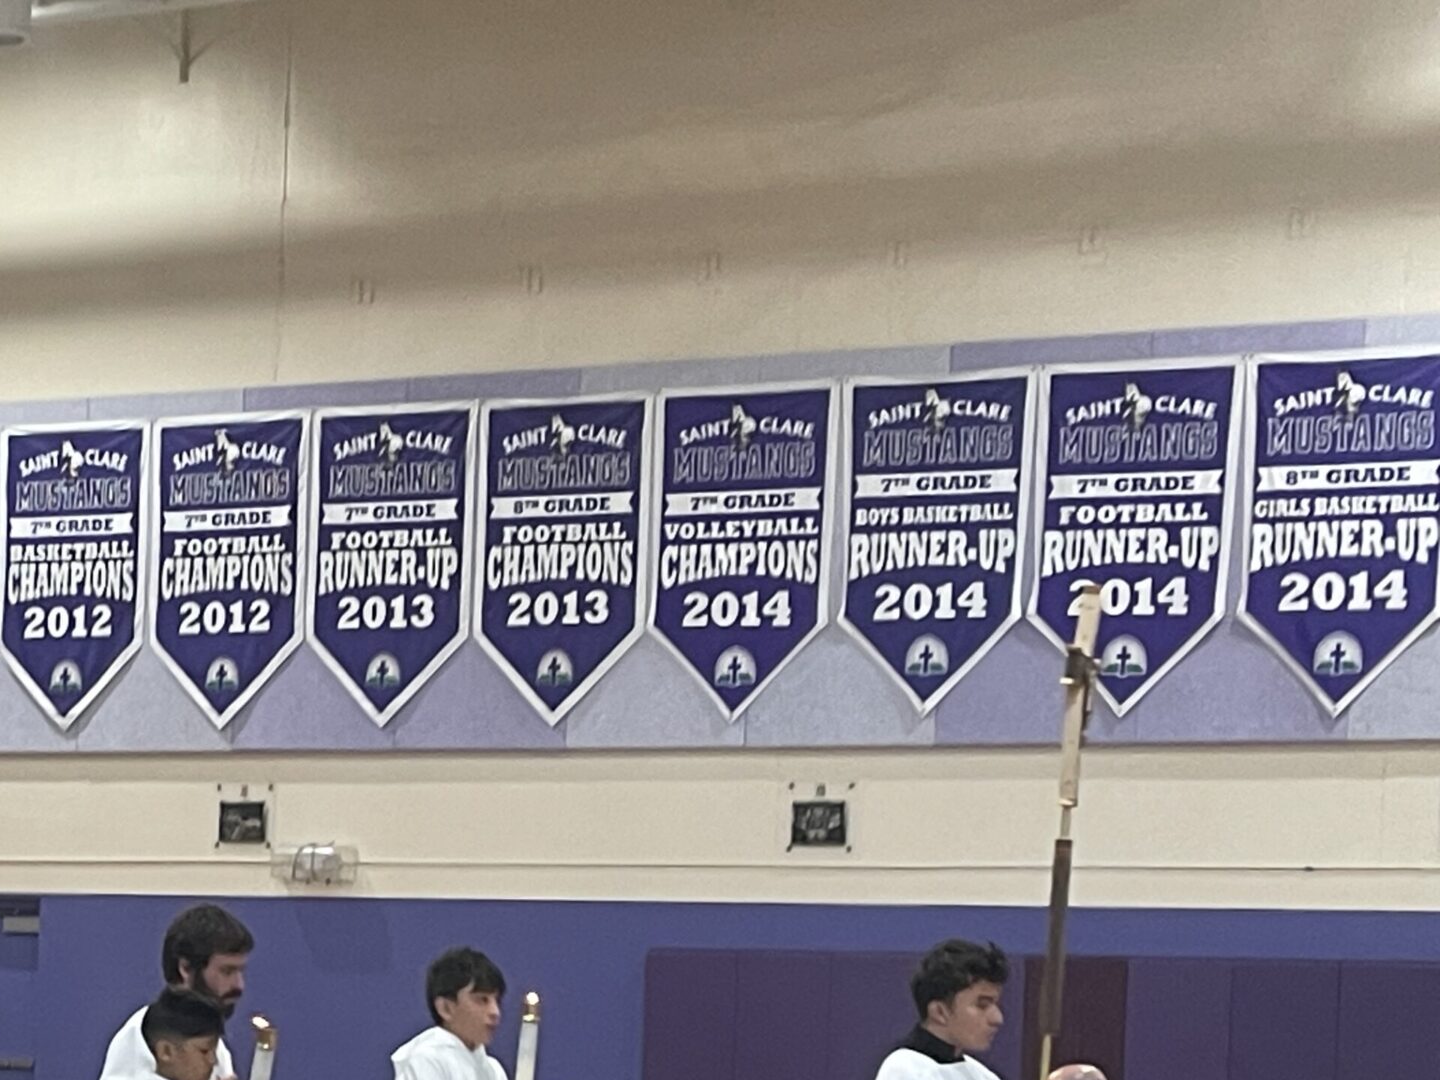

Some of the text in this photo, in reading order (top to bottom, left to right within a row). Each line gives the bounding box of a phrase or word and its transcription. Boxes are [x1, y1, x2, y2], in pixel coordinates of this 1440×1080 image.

[869, 400, 1012, 429] SAINT CLARE
[1066, 396, 1217, 425] SAINT CLARE
[1274, 384, 1434, 417] SAINT CLARE
[333, 430, 452, 460] SAINT CLARE
[503, 424, 627, 454] SAINT CLARE
[680, 416, 815, 445] SAINT CLARE
[863, 424, 1014, 467] MUSTANGS
[1059, 421, 1219, 465] MUSTANGS
[1266, 410, 1435, 456] MUSTANGS
[19, 449, 128, 477] SAINT CLARE
[173, 442, 286, 471] SAINT CLARE
[498, 452, 631, 491] MUSTANGS
[673, 441, 815, 484] MUSTANGS
[169, 469, 290, 506] MUSTANGS
[329, 460, 456, 498] MUSTANGS
[916, 474, 992, 491] GRADE
[1114, 476, 1195, 492] GRADE
[1326, 467, 1411, 484] GRADE
[15, 477, 131, 512] MUSTANGS
[544, 497, 610, 512] GRADE
[724, 493, 795, 509] GRADE
[1254, 492, 1440, 518] GIRLS BASKETBALL
[56, 518, 113, 532] GRADE
[212, 511, 271, 526] GRADE
[373, 504, 436, 519] GRADE
[855, 502, 1013, 527] BOYS BASKETBALL
[1059, 502, 1208, 525] FOOTBALL
[173, 534, 286, 556] FOOTBALL
[331, 528, 452, 550] FOOTBALL
[503, 522, 627, 544] FOOTBALL
[664, 517, 819, 540] VOLLEYBALL
[1250, 517, 1439, 573] RUNNER-UP
[10, 540, 134, 562] BASKETBALL
[487, 540, 634, 590] CHAMPIONS
[661, 539, 818, 589] CHAMPIONS
[848, 528, 1016, 581] RUNNER-UP
[1041, 525, 1219, 578] RUNNER-UP
[8, 560, 134, 605] CHAMPIONS
[161, 552, 292, 600] CHAMPIONS
[319, 547, 458, 596] RUNNER-UP
[873, 581, 988, 621] 2014
[1278, 569, 1408, 612] 2014
[24, 604, 112, 639] 2012
[179, 599, 270, 635] 2012
[338, 594, 435, 629] 2013
[507, 589, 609, 626] 2013
[682, 590, 791, 627] 2014
